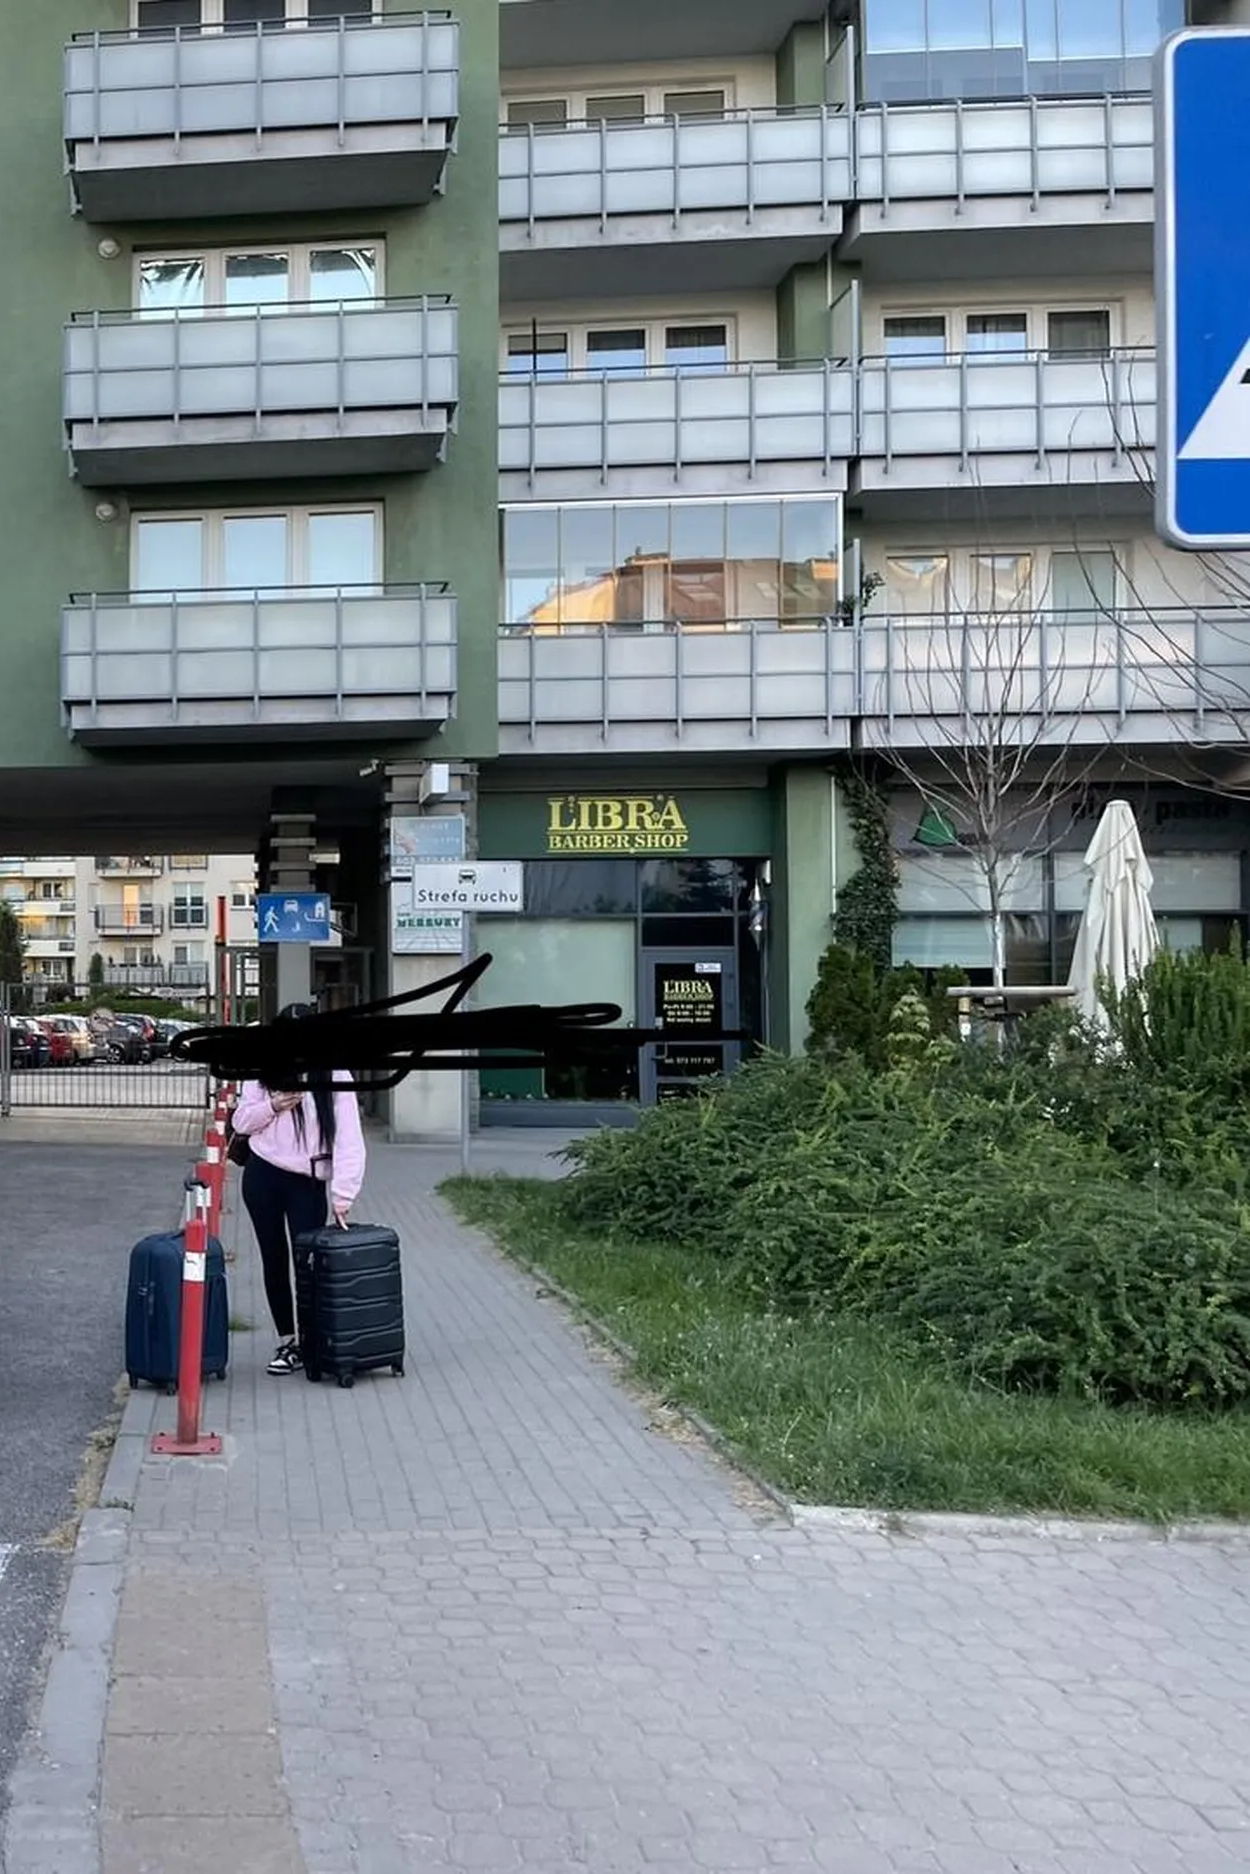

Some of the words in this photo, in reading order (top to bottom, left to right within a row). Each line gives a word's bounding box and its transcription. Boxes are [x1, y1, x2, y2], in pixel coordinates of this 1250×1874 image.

[548, 799, 686, 830] LIBRA
[549, 835, 634, 848] BARBER
[634, 834, 688, 847] SHOP
[417, 889, 468, 903] Strefa
[473, 889, 519, 903] ruchu
[663, 980, 713, 993] LIBRA
